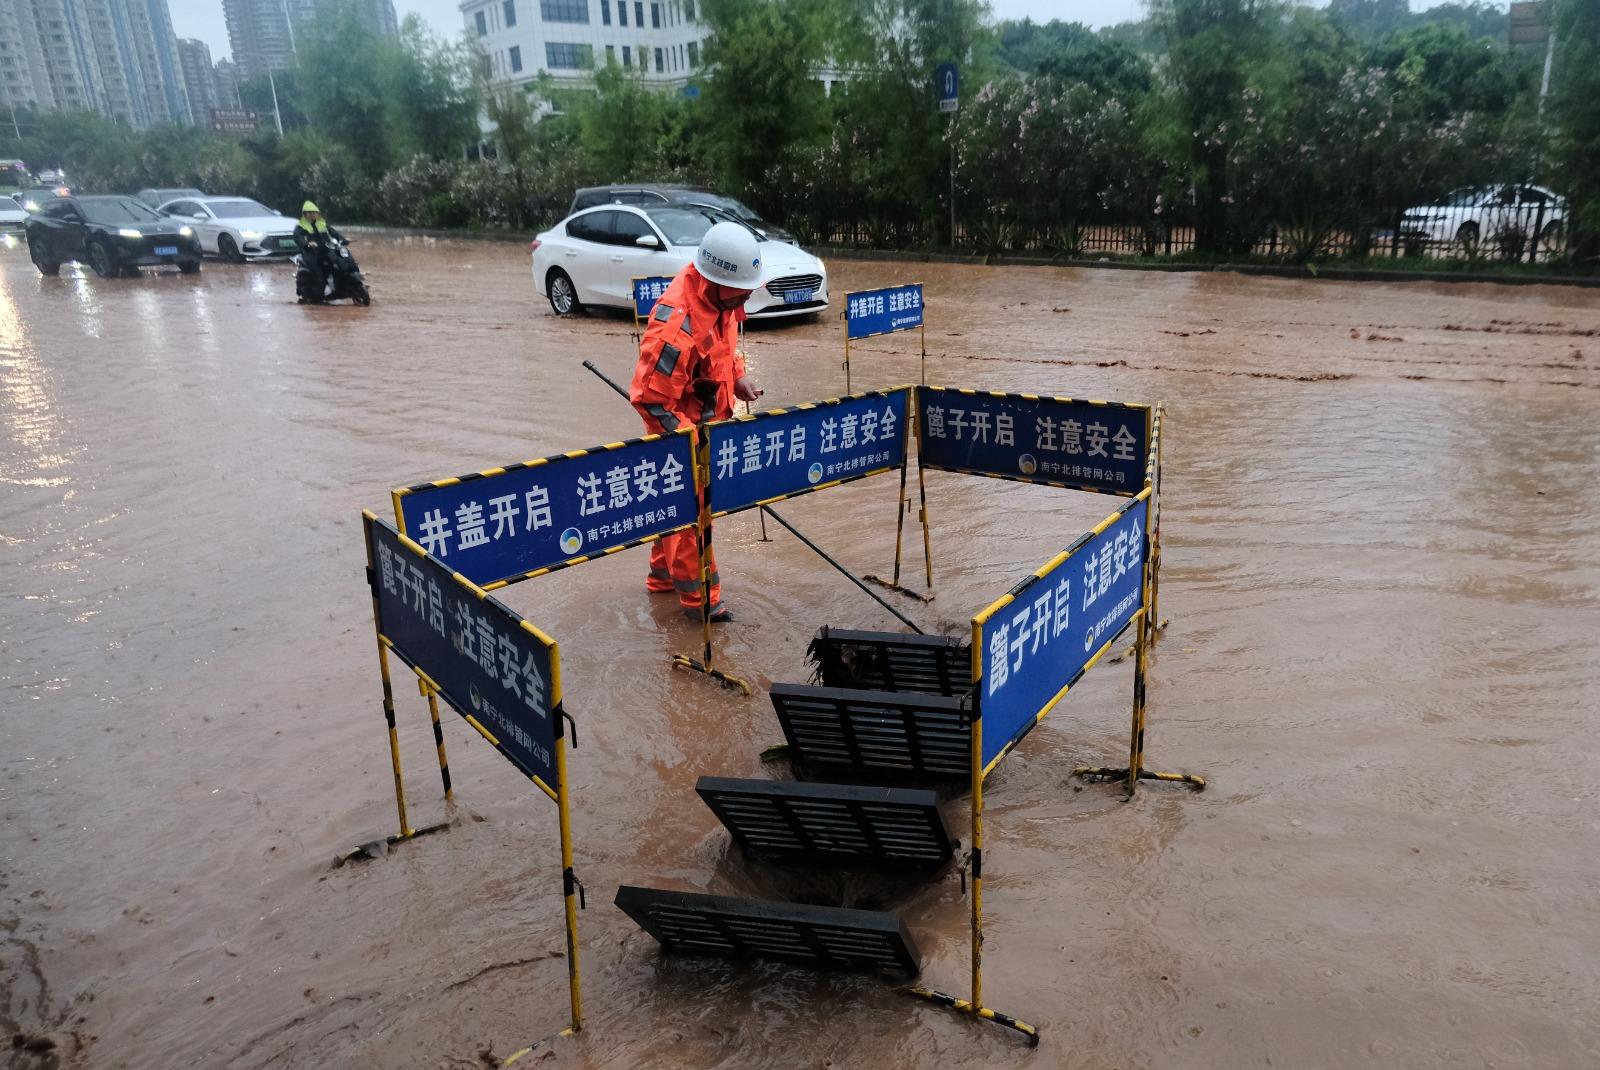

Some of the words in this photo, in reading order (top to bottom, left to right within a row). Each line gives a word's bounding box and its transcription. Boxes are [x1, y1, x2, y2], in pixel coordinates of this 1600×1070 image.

[850, 295, 884, 319] 井盖开启
[889, 290, 920, 312] 注意安全
[717, 424, 806, 481] 井盖开启
[820, 405, 897, 454] 注意安全
[826, 451, 890, 476] 南宁北排管网公司
[926, 404, 1015, 447] 篦子开启
[1035, 416, 1137, 461] 注意安全
[1040, 461, 1126, 484] 南宁北排管网公司
[419, 485, 553, 557] 井盖开启
[576, 453, 685, 517] 注意安全
[587, 505, 677, 543] 南宁北排管网公司
[378, 538, 446, 638] 篦子开启
[457, 600, 547, 719] 注意安全
[989, 577, 1070, 697] 篦子开启
[1082, 518, 1141, 612] 注意安全
[482, 698, 550, 768] 南宁北排管网公司
